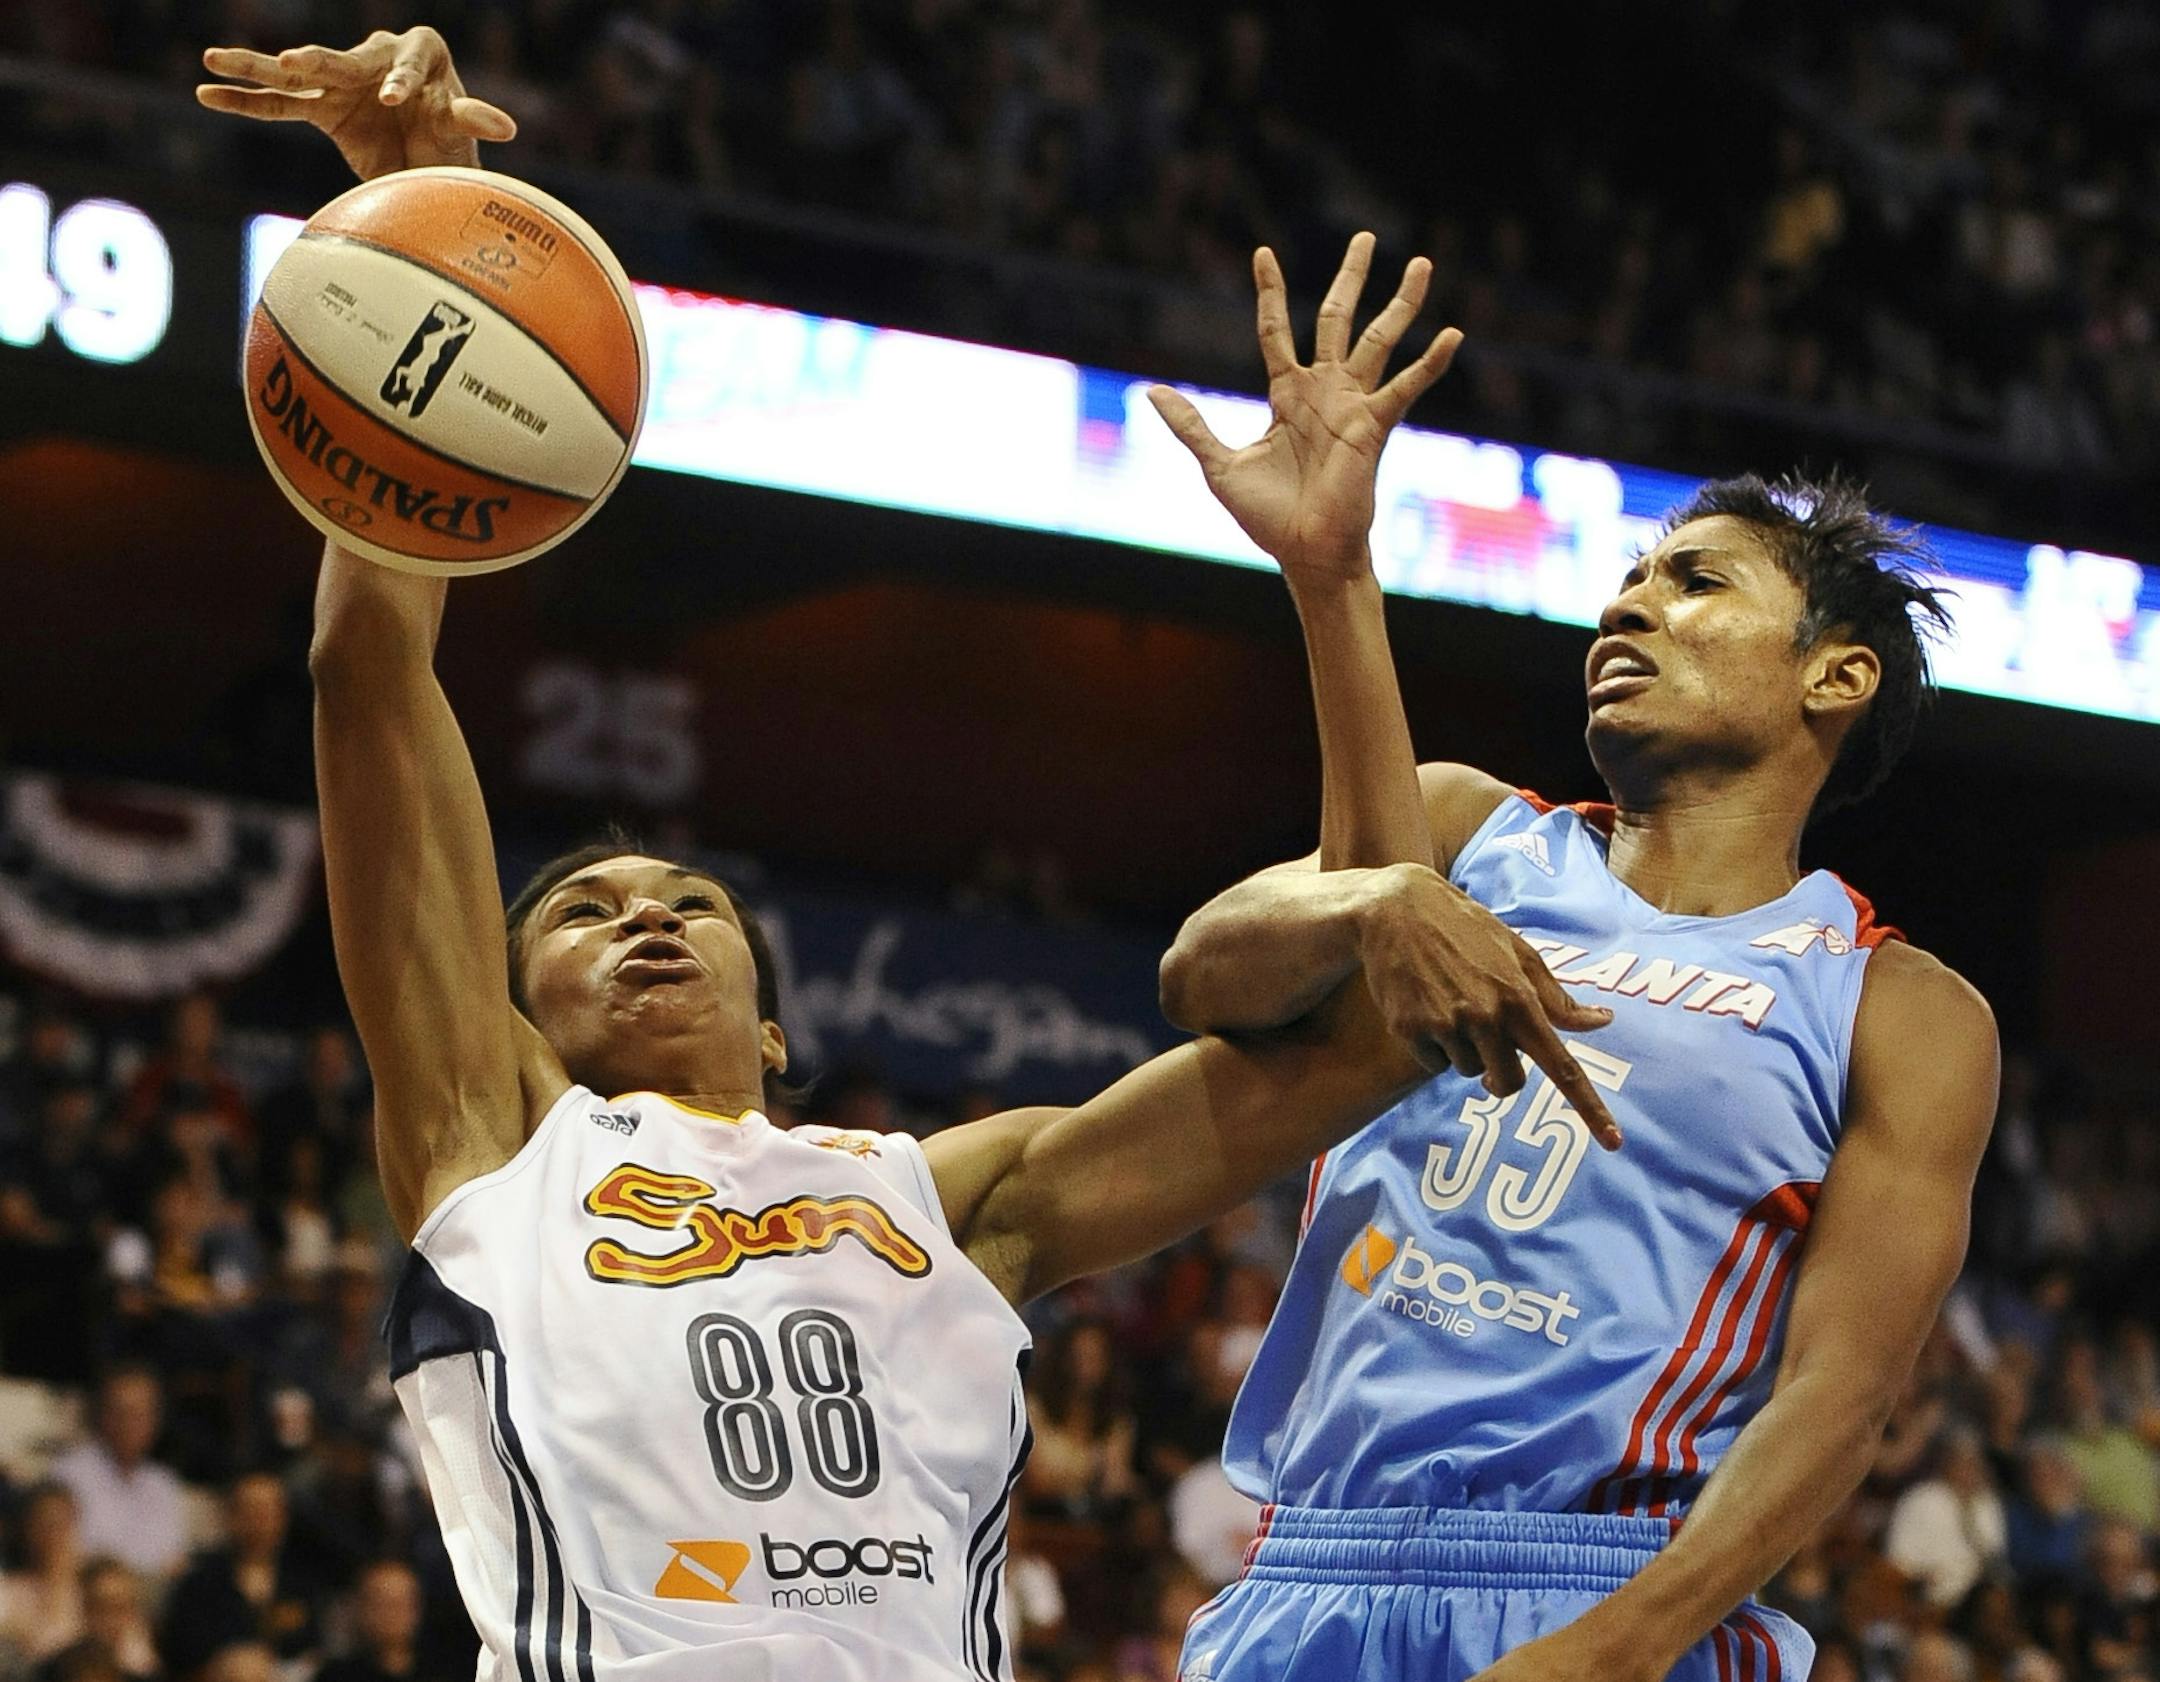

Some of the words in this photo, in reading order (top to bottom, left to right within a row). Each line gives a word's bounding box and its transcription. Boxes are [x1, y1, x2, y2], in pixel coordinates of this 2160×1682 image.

[260, 354, 510, 542] SPALDING
[1511, 928, 1777, 1031] TLANTA
[1420, 1039, 1633, 1231] 35
[583, 1162, 933, 1288] Sun
[1380, 1289, 1476, 1338] mobile
[1393, 1236, 1581, 1347] boost
[686, 1308, 881, 1502] 88
[760, 1532, 935, 1586] boost
[771, 1582, 878, 1609] mobile
